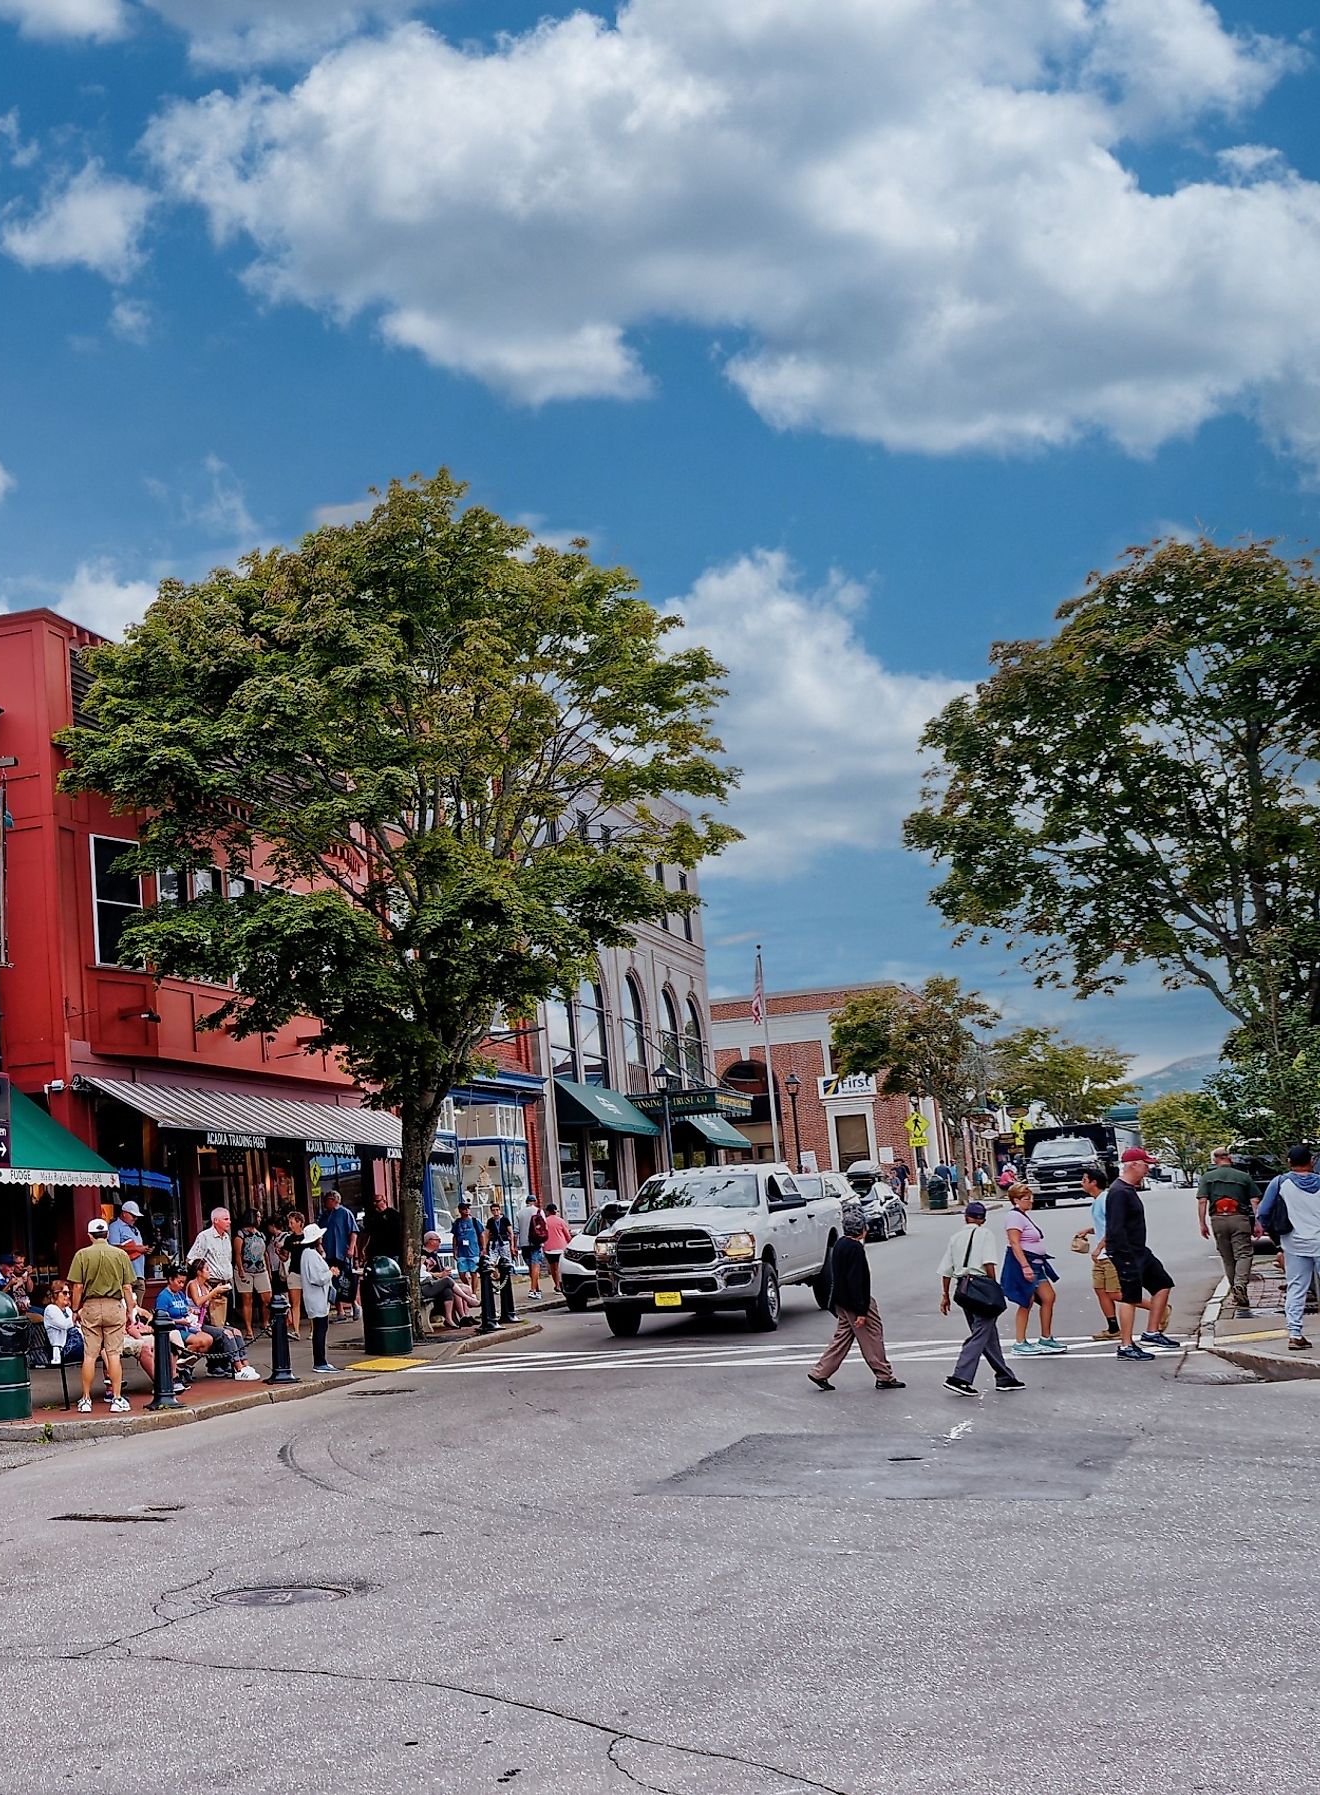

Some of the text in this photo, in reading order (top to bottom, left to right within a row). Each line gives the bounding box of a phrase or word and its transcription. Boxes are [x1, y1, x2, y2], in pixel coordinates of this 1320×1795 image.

[841, 1076, 871, 1088] First
[11, 1170, 31, 1180] FUDGE
[643, 1240, 684, 1250] RAM
